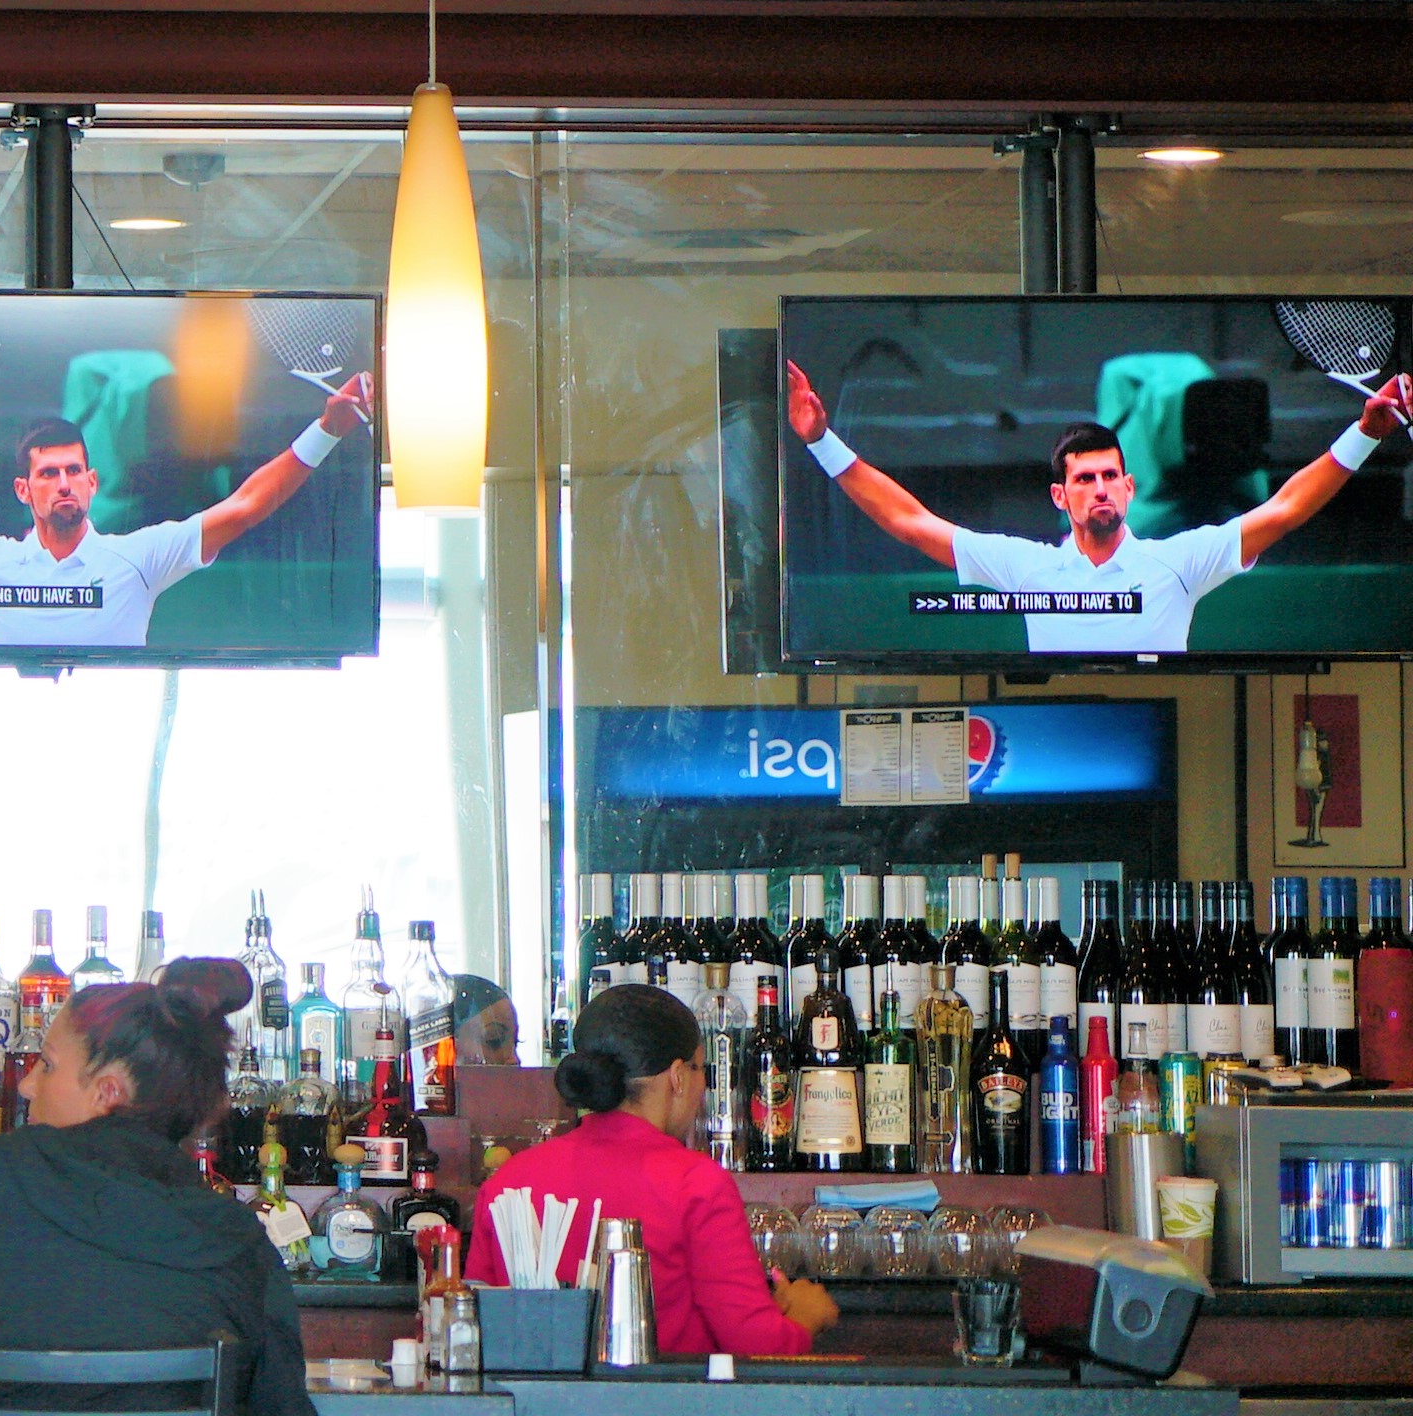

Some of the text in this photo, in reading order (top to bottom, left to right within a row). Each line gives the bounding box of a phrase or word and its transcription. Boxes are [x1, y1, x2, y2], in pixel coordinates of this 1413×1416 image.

[15, 587, 40, 603] YOU
[42, 588, 74, 604] HAVE
[77, 588, 94, 604] TO
[952, 593, 976, 610] THE
[979, 593, 1010, 610] ONLY
[1013, 593, 1051, 610] THING
[1054, 593, 1078, 610] YOU
[1081, 593, 1113, 610] HAVE
[1116, 593, 1133, 610] TO
[981, 1073, 1023, 1089] BAILEYS
[803, 1084, 853, 1102] Frangelico
[1041, 1091, 1073, 1106] BUD
